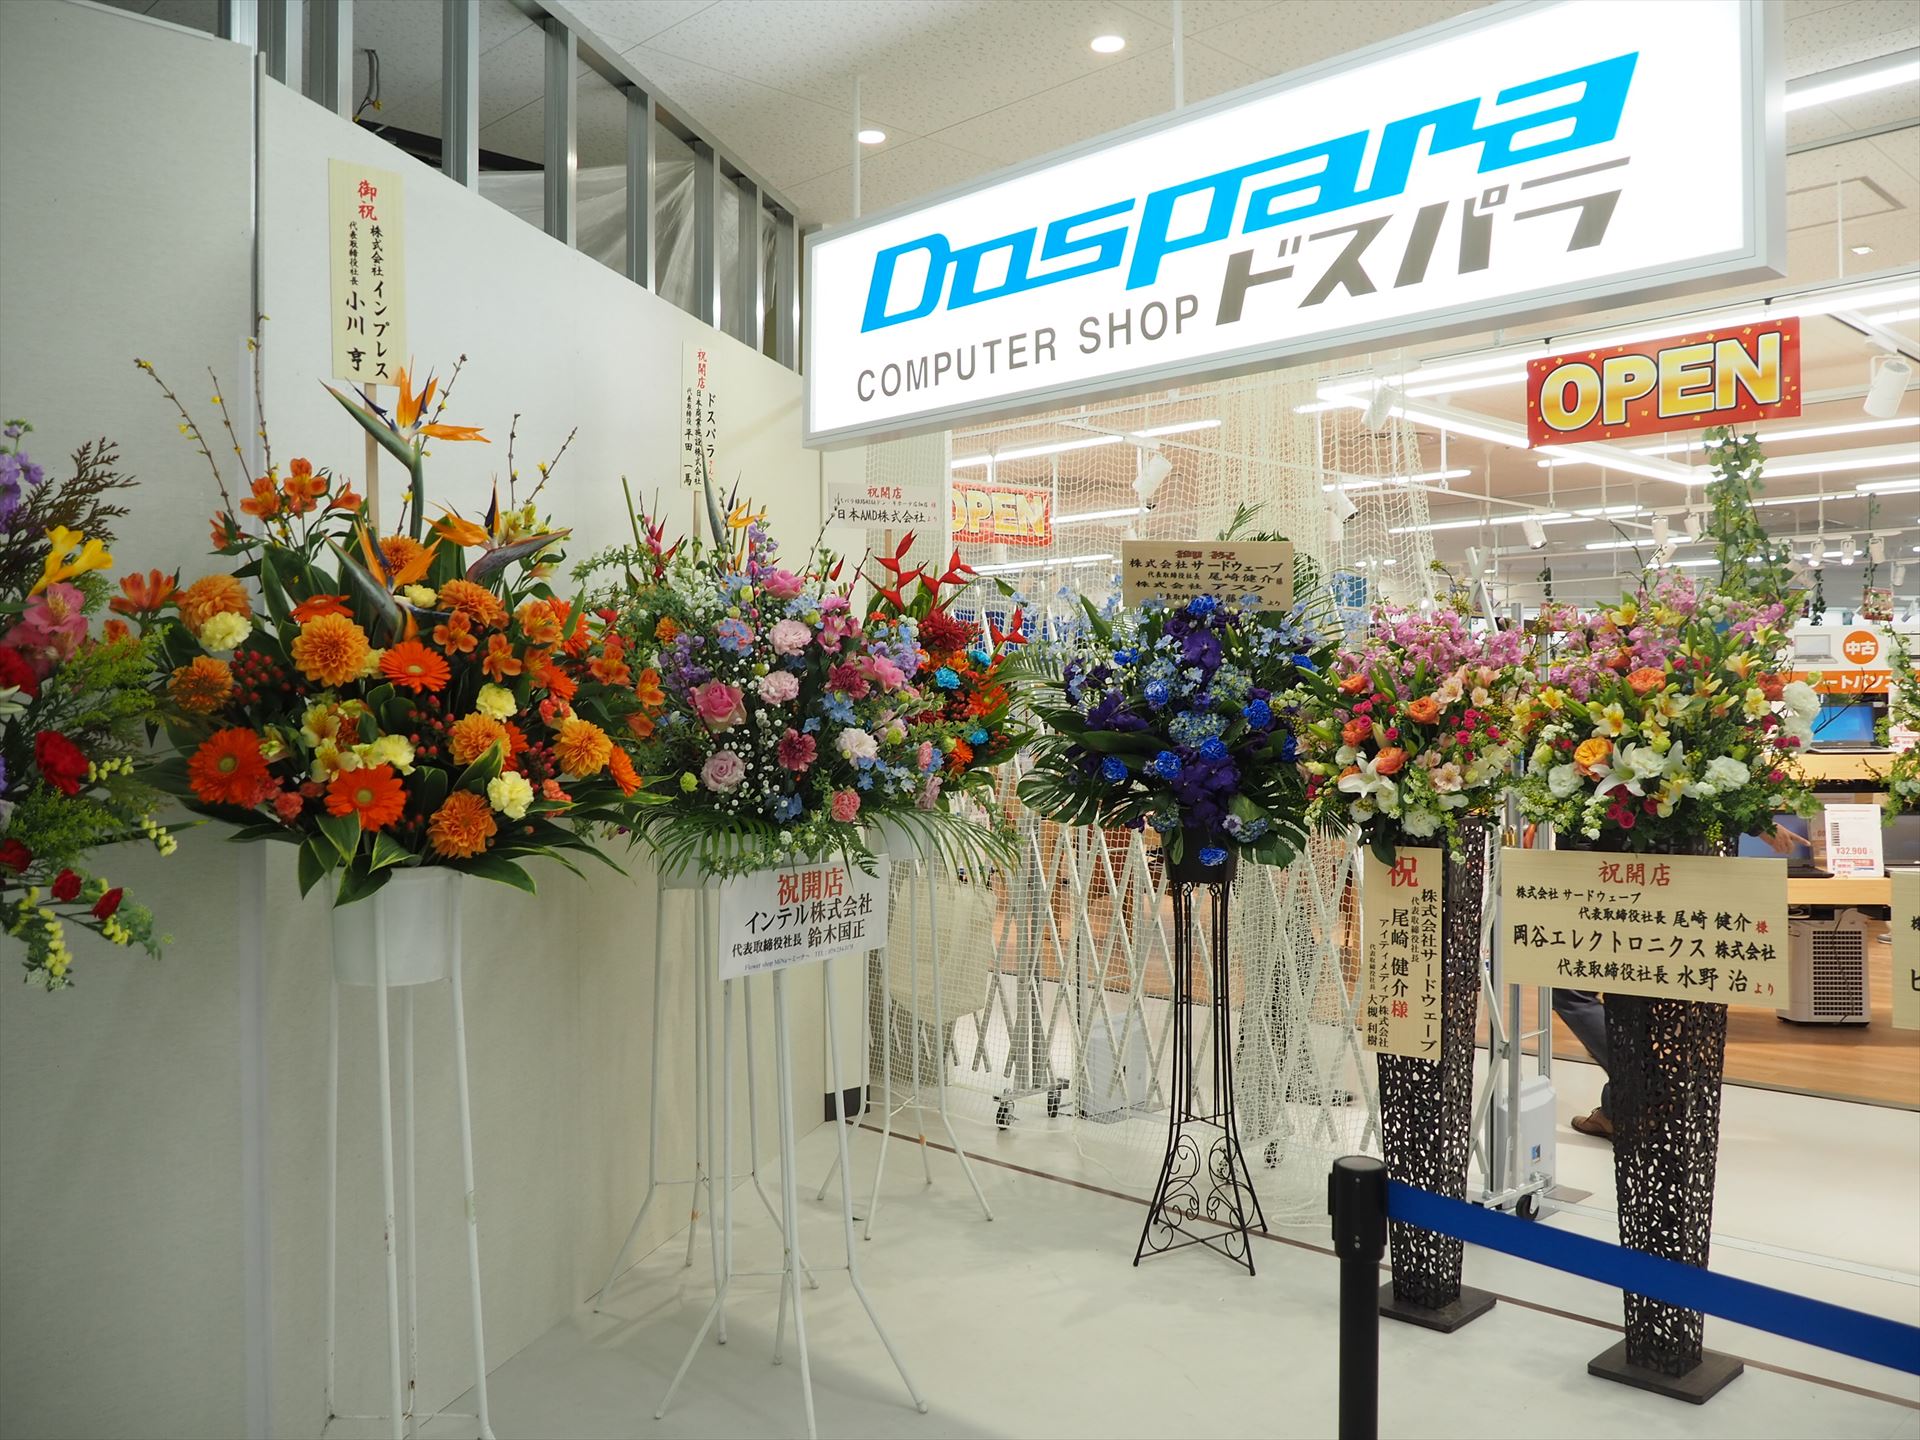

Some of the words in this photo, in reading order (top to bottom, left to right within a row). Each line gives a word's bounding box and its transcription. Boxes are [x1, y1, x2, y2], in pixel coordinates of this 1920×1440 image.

[358, 180, 377, 221] 御祝
[860, 51, 1639, 333] Dospara
[1216, 156, 1631, 326] ドスパラ
[857, 327, 1057, 402] COMPUTER
[1079, 294, 1199, 355] SHOP
[697, 351, 707, 389] 祝開店
[1540, 331, 1782, 432] OPEN
[867, 486, 902, 499] 祝開店
[1845, 641, 1876, 656] 中古
[777, 867, 844, 906] 祝開店
[1387, 856, 1419, 887] 祝
[1598, 860, 1672, 887] 祝開店
[745, 892, 873, 934] インテル株式会社
[1578, 906, 1667, 925] 代表取締役社長
[731, 932, 802, 958] 代表取締役社長
[807, 919, 866, 949] 鈴木国正
[1557, 957, 1669, 984] 代表取締役社長
